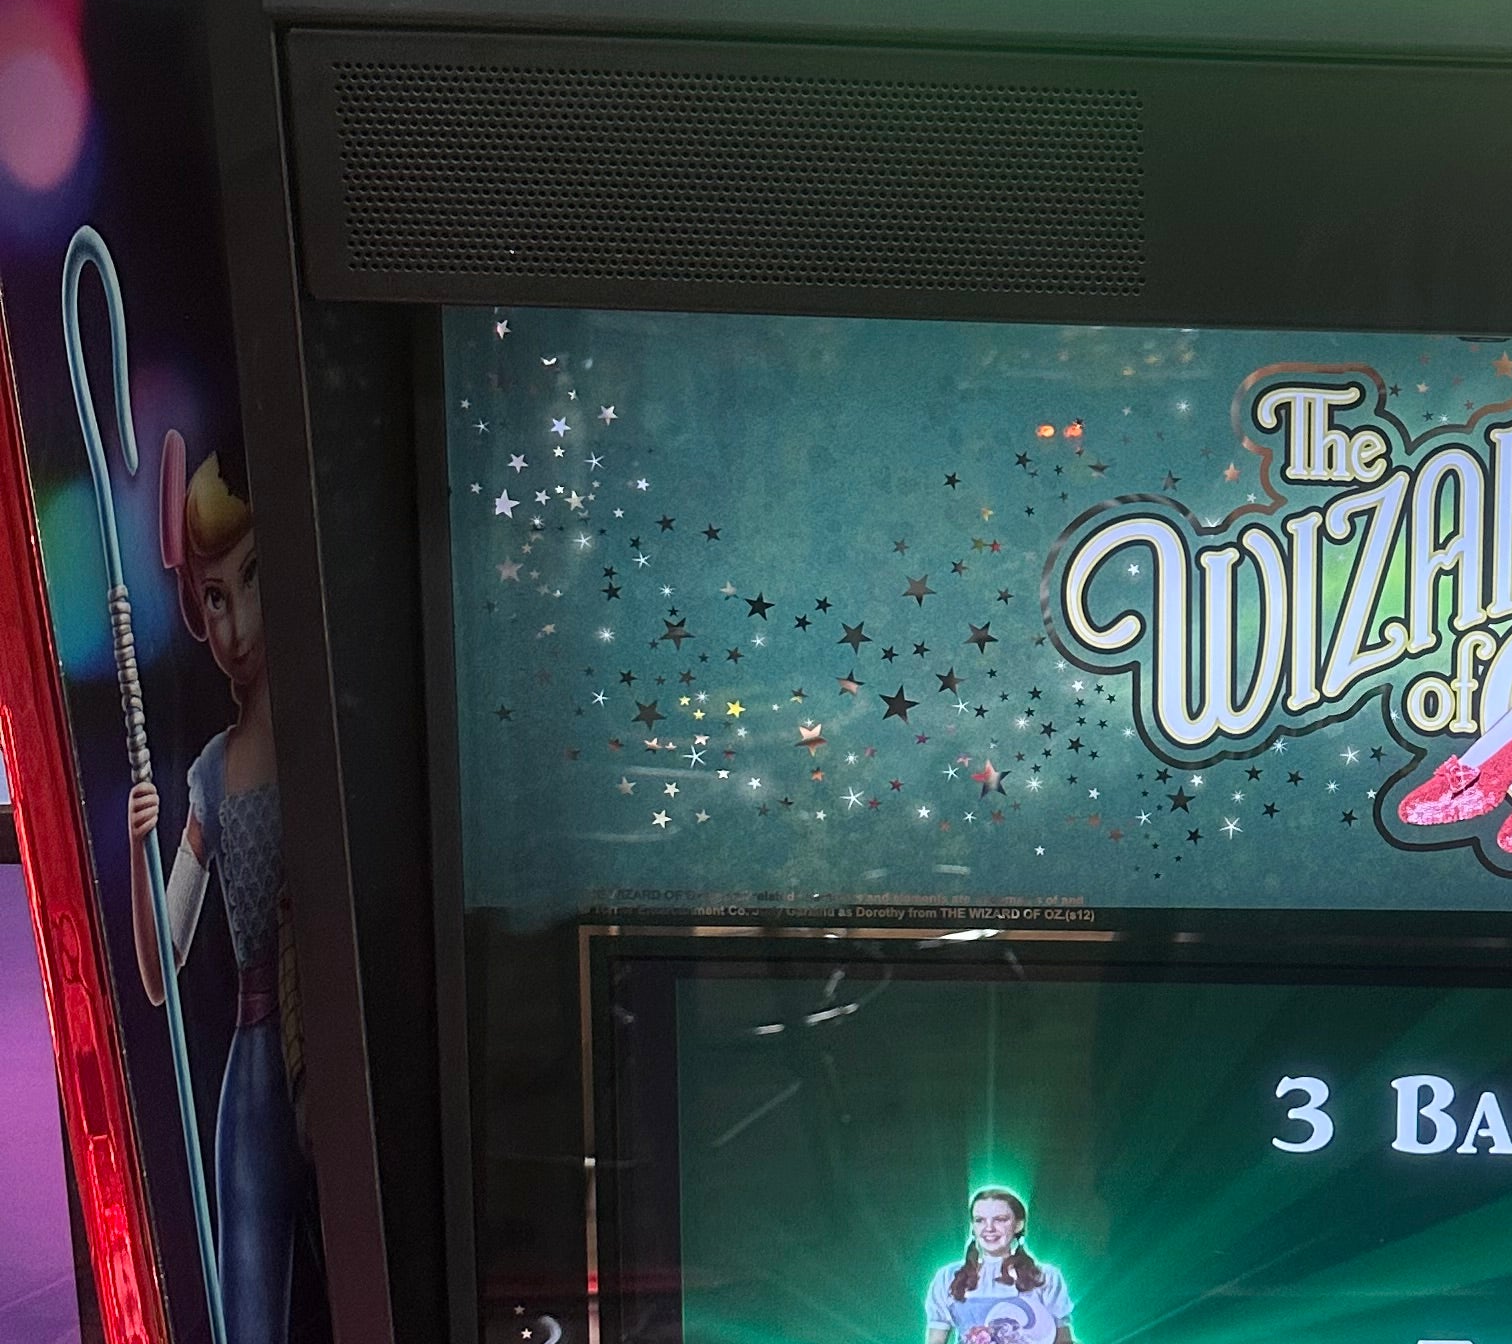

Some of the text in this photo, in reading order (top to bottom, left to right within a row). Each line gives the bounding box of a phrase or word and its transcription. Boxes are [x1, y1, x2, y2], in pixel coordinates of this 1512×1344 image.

[1256, 381, 1391, 484] The
[1406, 623, 1497, 735] of
[856, 907, 905, 921] Dorothy
[908, 908, 937, 919] from
[940, 907, 966, 919] THE
[970, 908, 1020, 920] WIZARD
[1023, 909, 1041, 920] OF
[1271, 1074, 1334, 1154] 3
